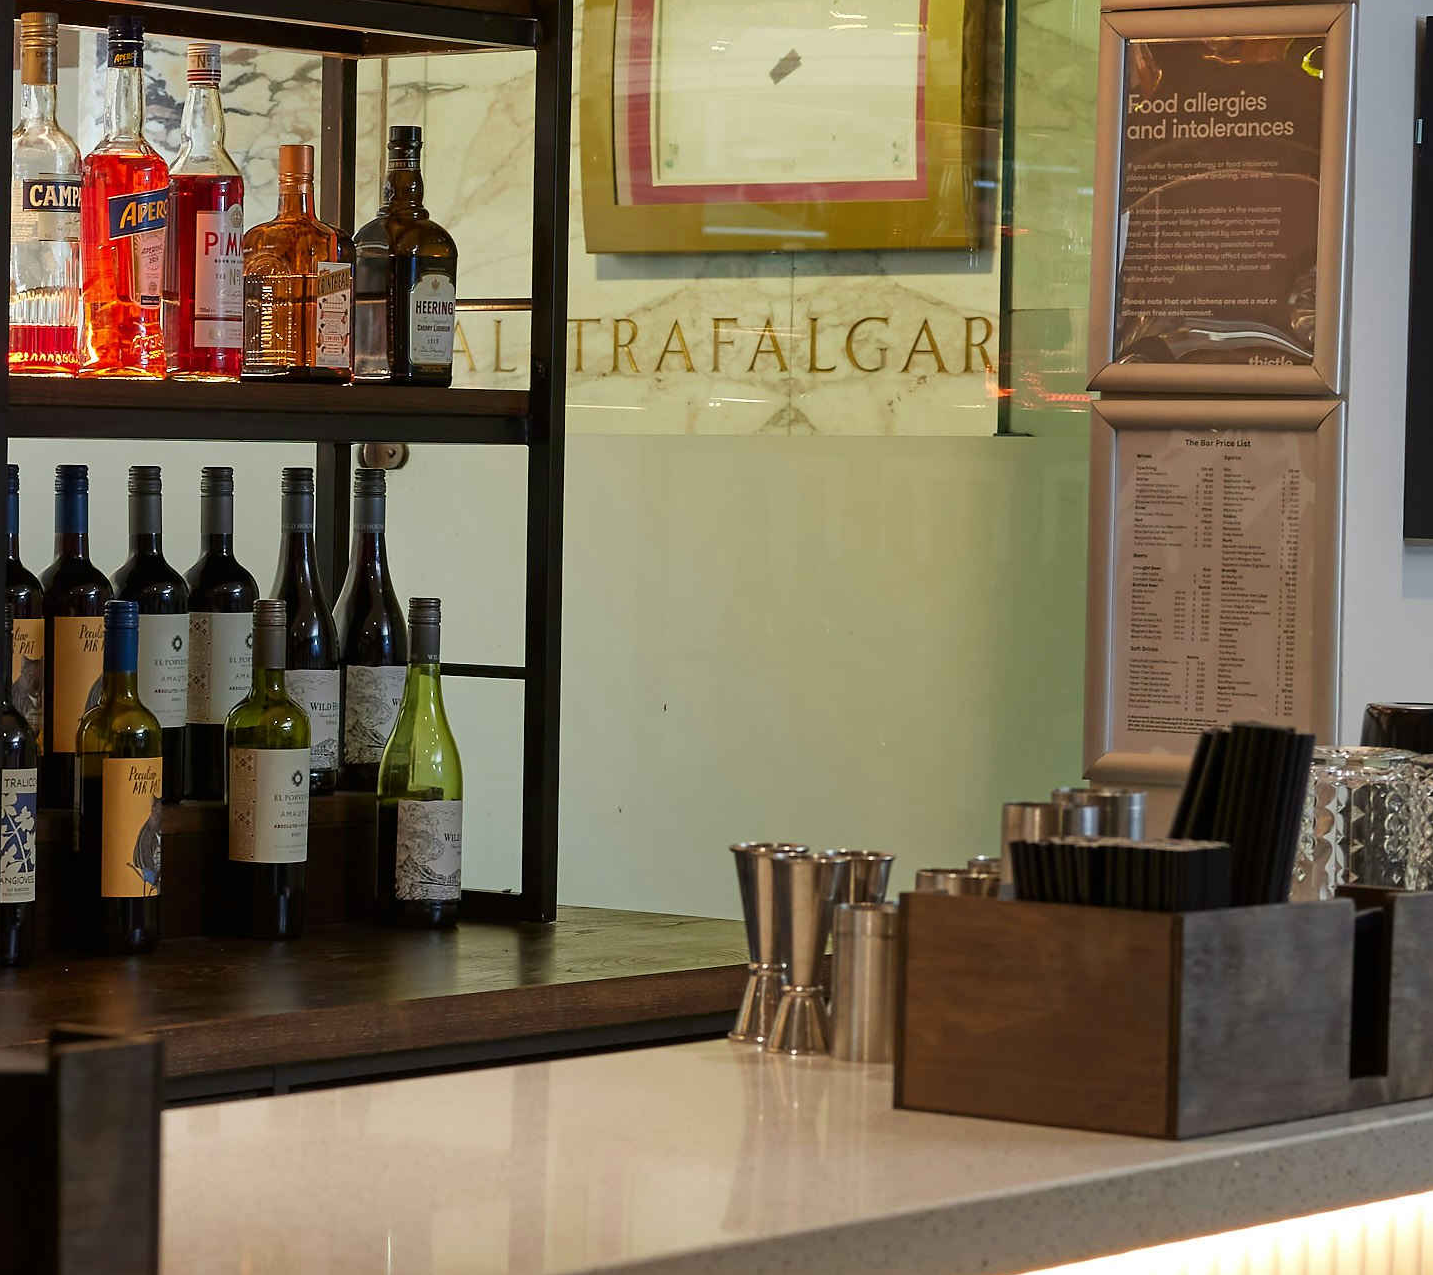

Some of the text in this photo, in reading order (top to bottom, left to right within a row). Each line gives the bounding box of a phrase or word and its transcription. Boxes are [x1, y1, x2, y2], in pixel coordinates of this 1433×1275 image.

[1127, 93, 1267, 118] Food allergies
[1126, 118, 1294, 141] and intolerances
[415, 300, 454, 315] HEERING
[417, 324, 433, 332] CHERRY
[567, 315, 999, 375] TRAFALGAR
[1185, 439, 1198, 447] The
[1216, 440, 1235, 448] Price
[1237, 440, 1251, 448] List
[310, 702, 331, 711] WILD
[133, 780, 147, 794] MR
